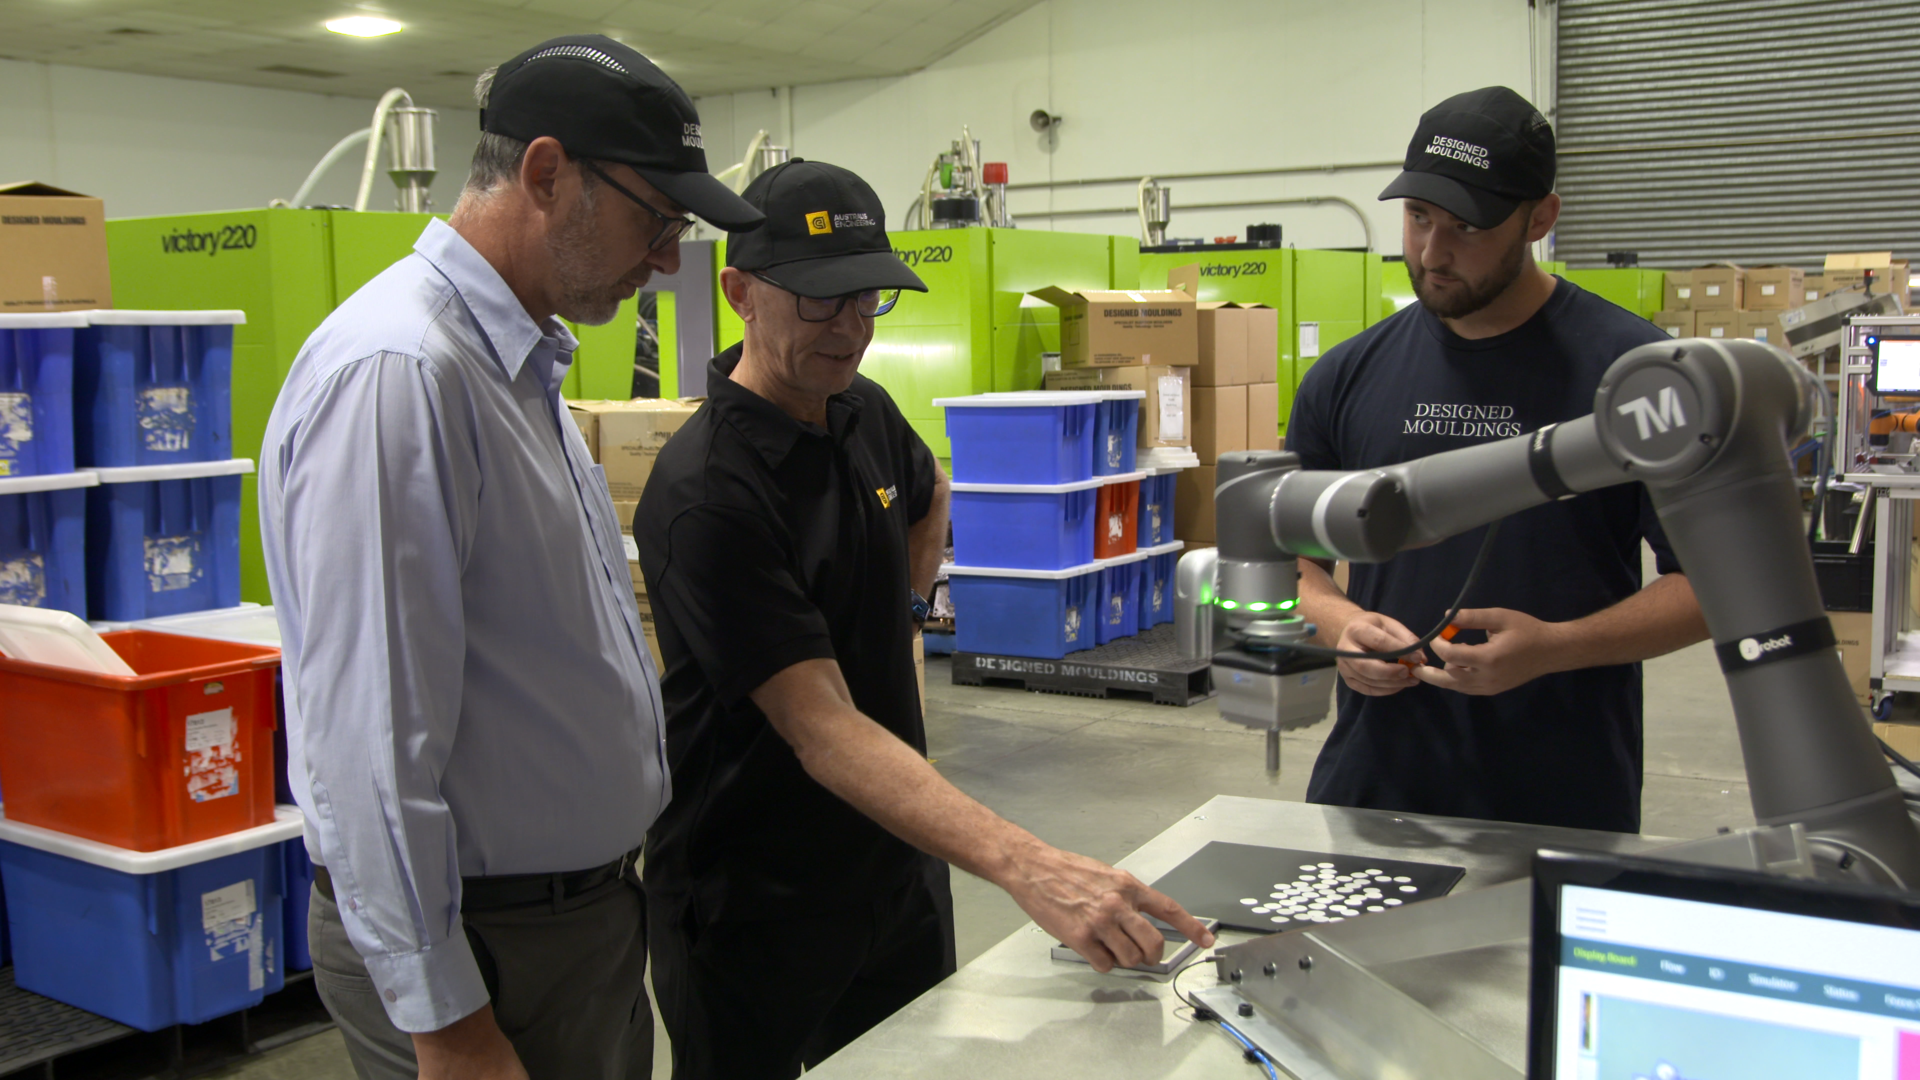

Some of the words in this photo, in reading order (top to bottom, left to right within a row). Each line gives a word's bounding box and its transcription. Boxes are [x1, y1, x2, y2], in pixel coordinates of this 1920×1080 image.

[1425, 144, 1491, 170] MOULDINGS
[1432, 135, 1488, 158] DESIGNED
[1103, 308, 1139, 318] DESIGNED
[1140, 308, 1182, 317] MOULDINGS
[1414, 403, 1514, 420] DESIGNED
[1616, 386, 1687, 441] TM
[1402, 419, 1521, 437] MOULDINGS
[975, 656, 1055, 675] DESIGNED
[1061, 664, 1159, 684] MOULDINGS
[1573, 946, 1607, 964] Display
[1607, 951, 1638, 968] Board
[1660, 959, 1687, 975] Flow
[1748, 972, 1799, 993] Simulator
